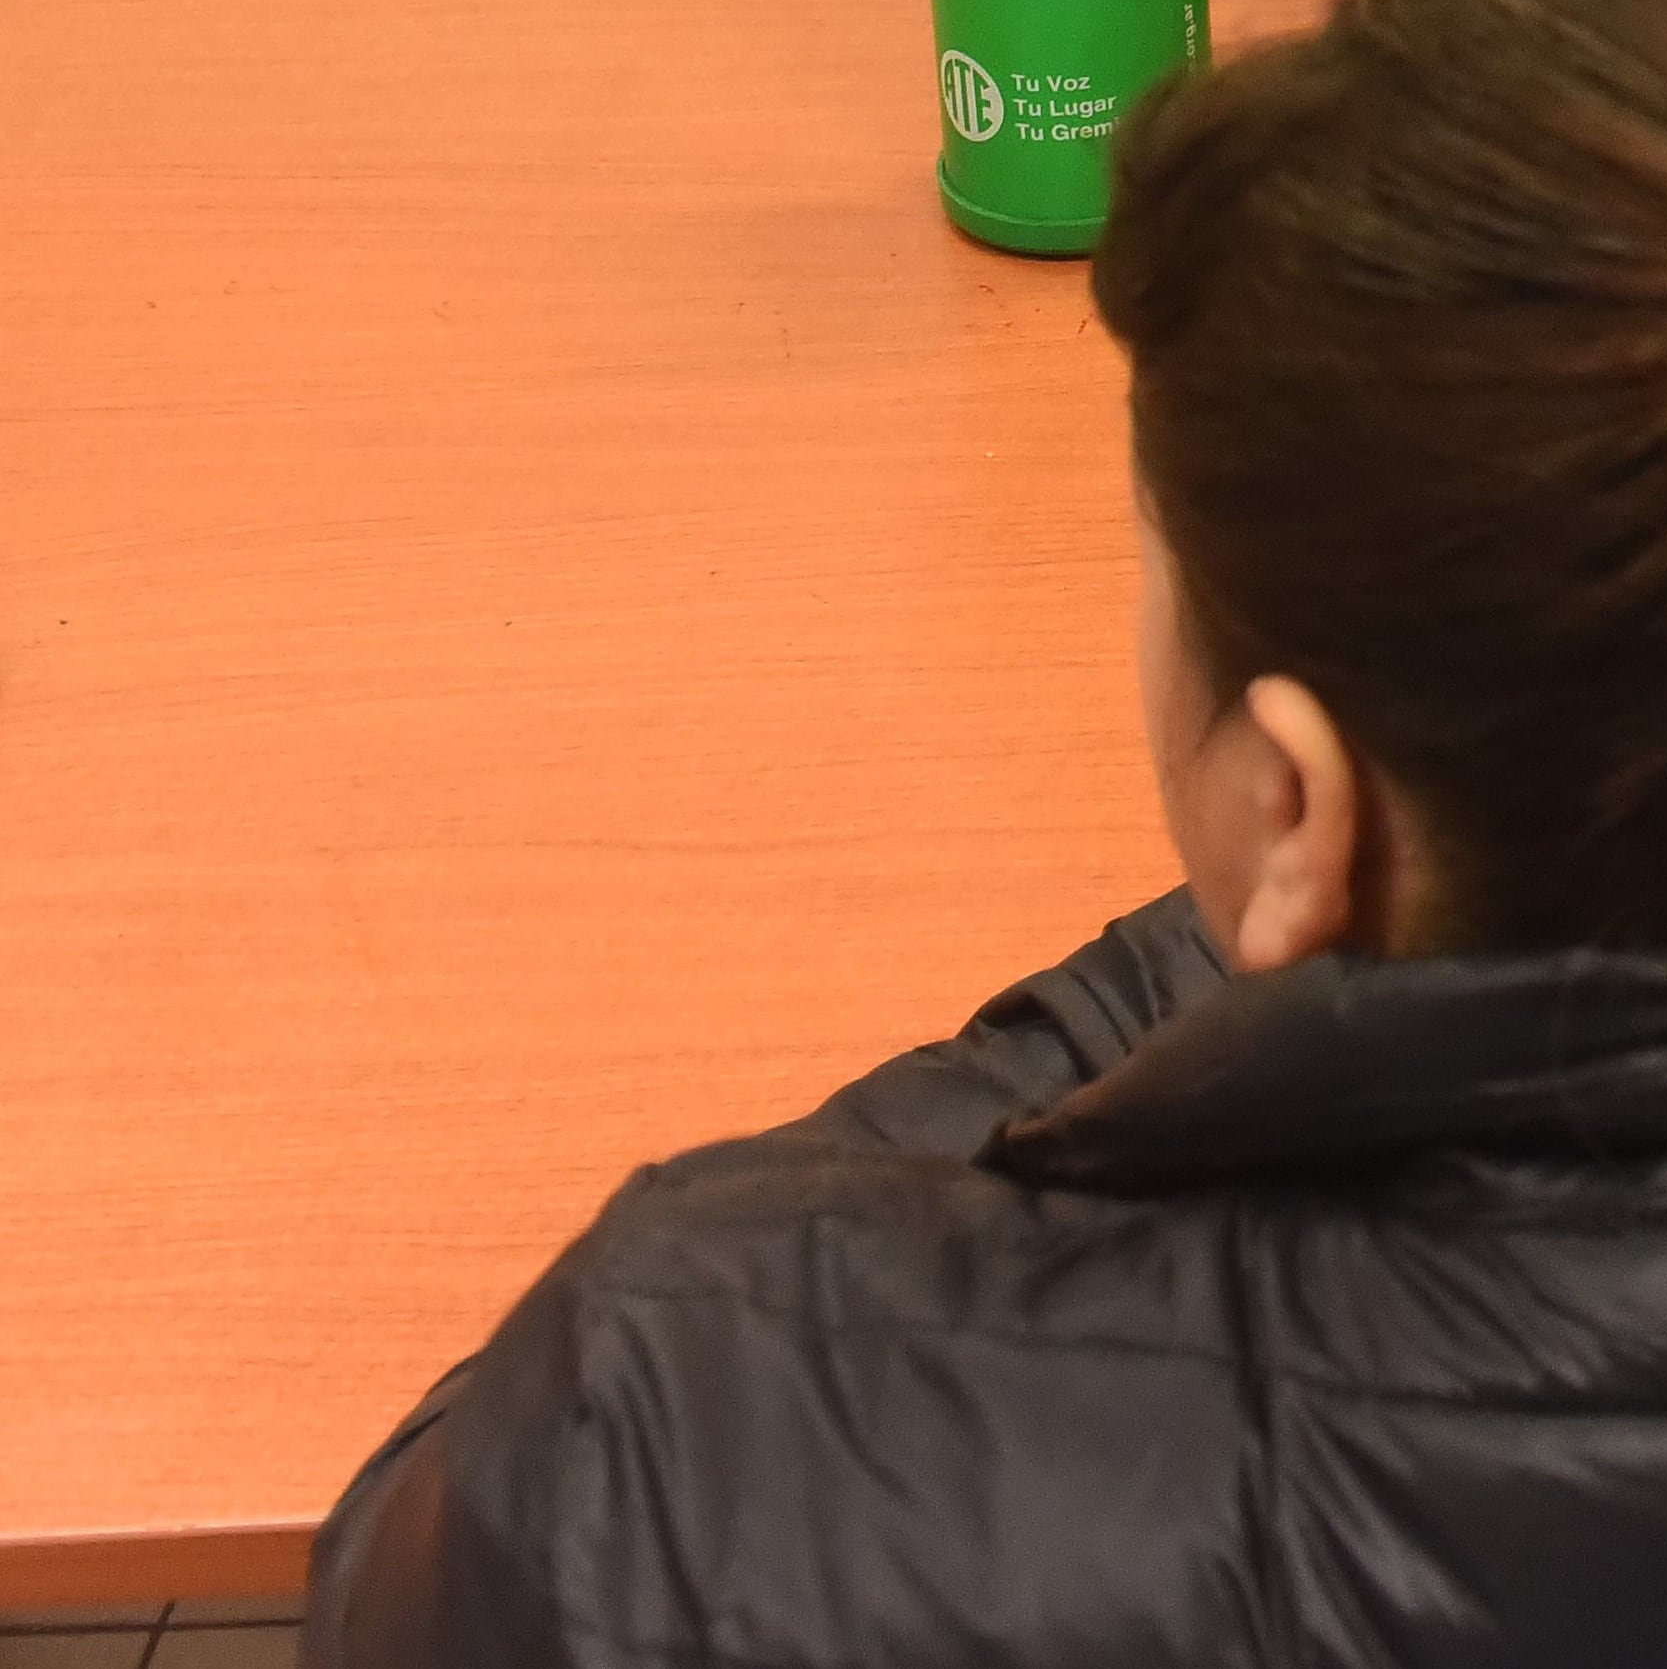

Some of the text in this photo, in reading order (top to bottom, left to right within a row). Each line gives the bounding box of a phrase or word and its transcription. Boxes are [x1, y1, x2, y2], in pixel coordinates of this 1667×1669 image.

[1011, 73, 1091, 92] Tu Voz
[942, 53, 1003, 140] ATE
[1014, 96, 1117, 119] Tu Lugar
[1015, 117, 1121, 142] Tu Grem
